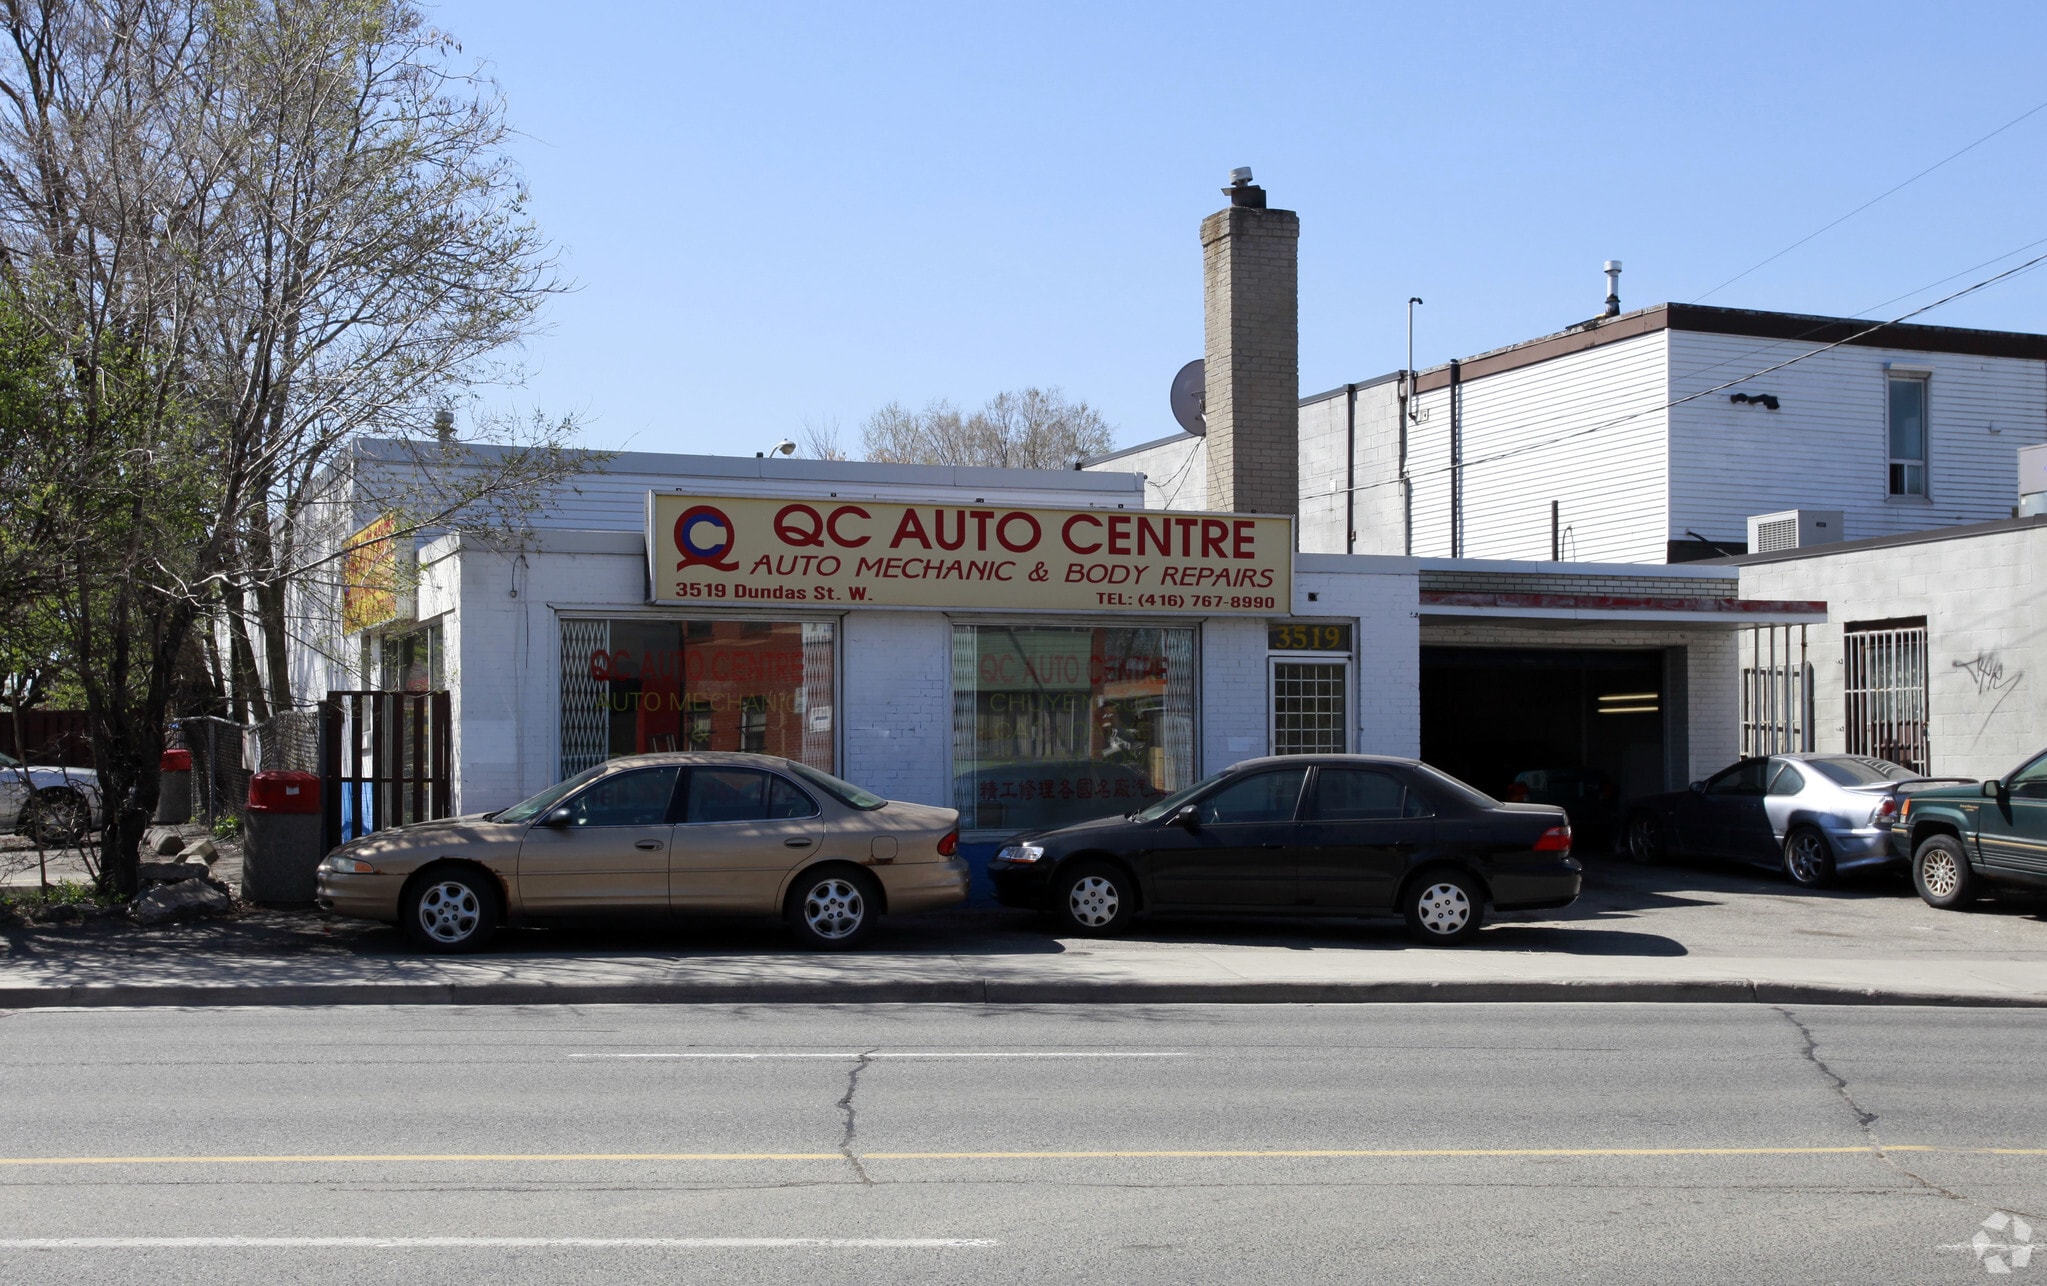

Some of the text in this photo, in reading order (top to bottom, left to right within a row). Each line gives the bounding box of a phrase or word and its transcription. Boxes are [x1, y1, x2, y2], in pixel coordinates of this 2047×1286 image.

[773, 504, 1256, 560] QC AUTO CENTRE
[749, 555, 1275, 589] AUTO MECHANIC & BODY REPAIRS
[675, 582, 873, 601] 3519 Dundas St. W.
[1096, 592, 1276, 609] TEL: (416) 767-8990
[1275, 624, 1340, 650] 3519
[590, 648, 804, 684] QC AUTO CENTRE
[979, 653, 1168, 686] QC AUTO CENTRE
[595, 690, 662, 712] AUTO
